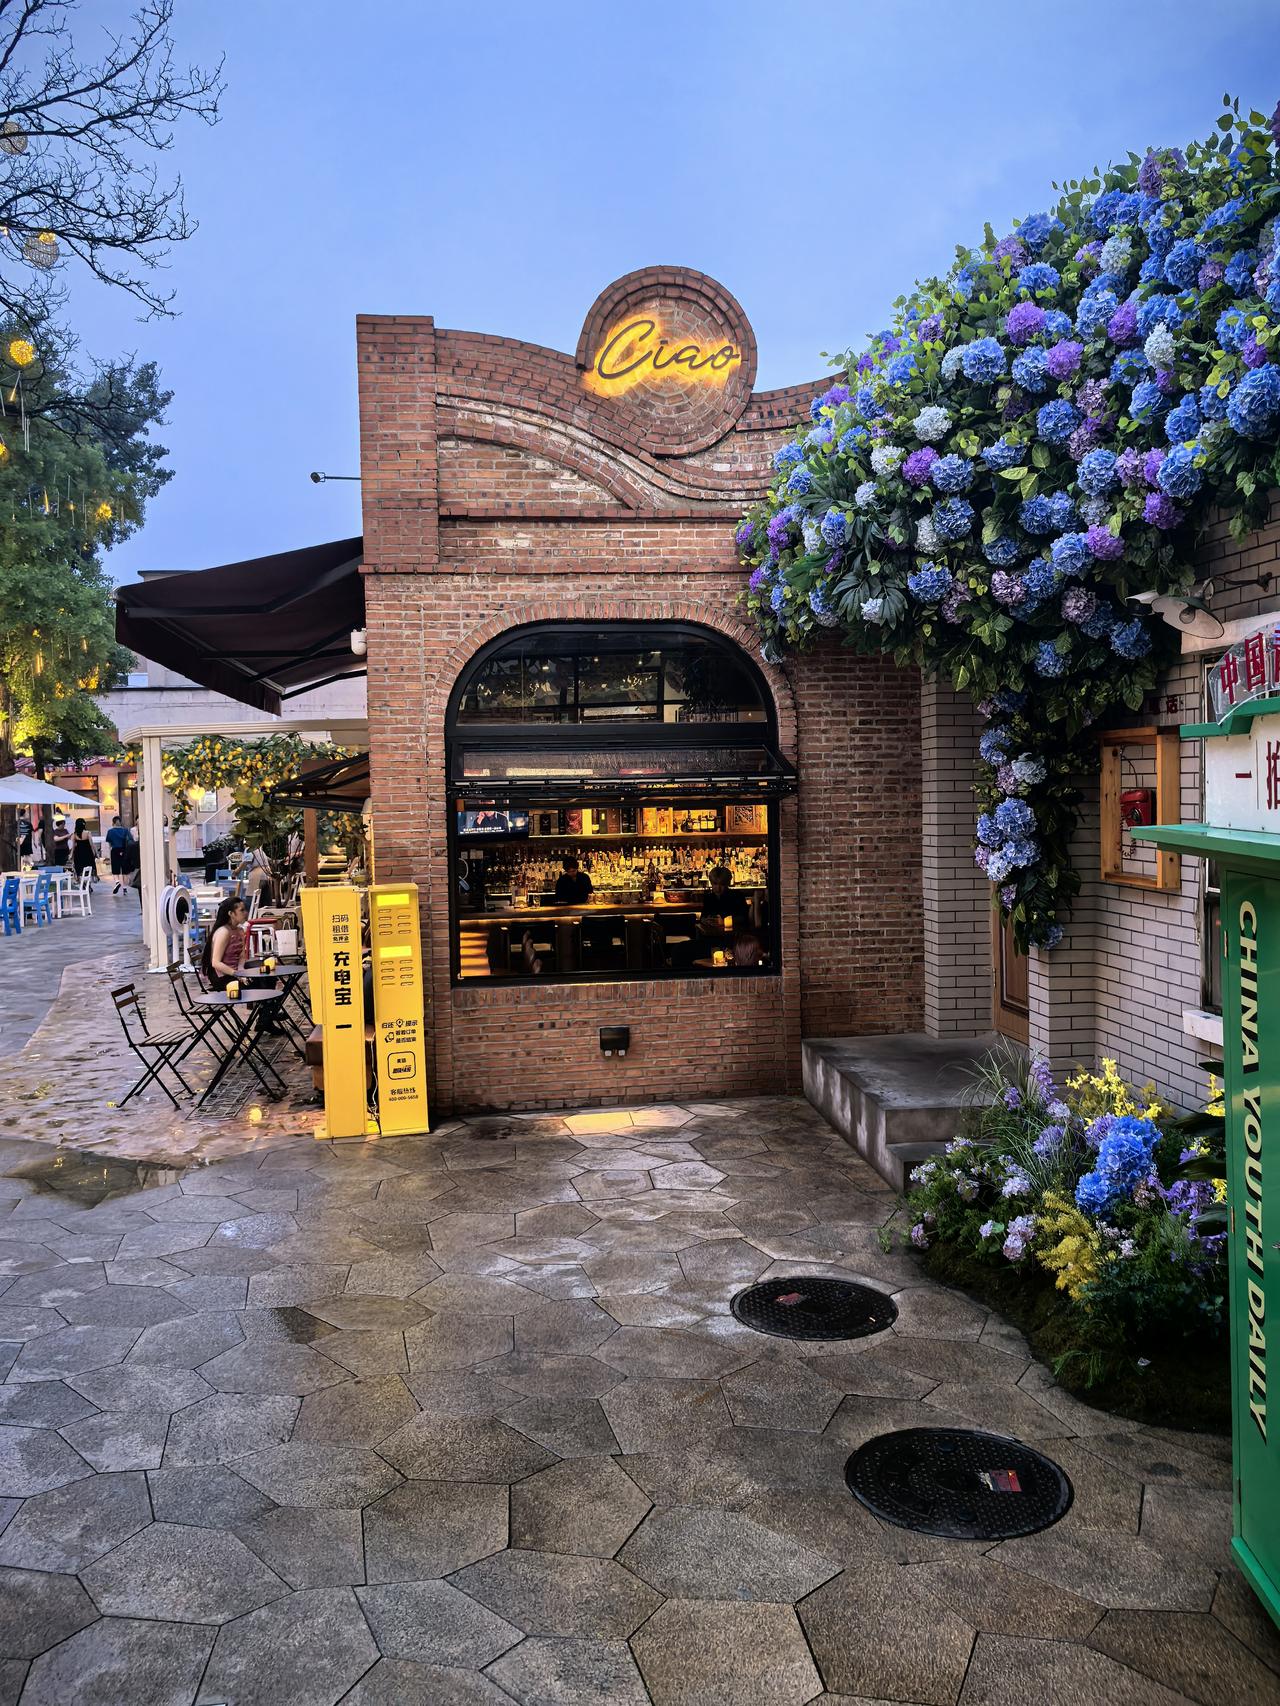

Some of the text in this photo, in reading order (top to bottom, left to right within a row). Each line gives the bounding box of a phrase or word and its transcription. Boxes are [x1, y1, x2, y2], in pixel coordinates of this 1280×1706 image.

[597, 320, 740, 380] Ciao
[332, 914, 349, 924] 扫码
[333, 951, 352, 1006] 充电宝
[1239, 900, 1267, 1446] CHINA YOUTH DAILY
